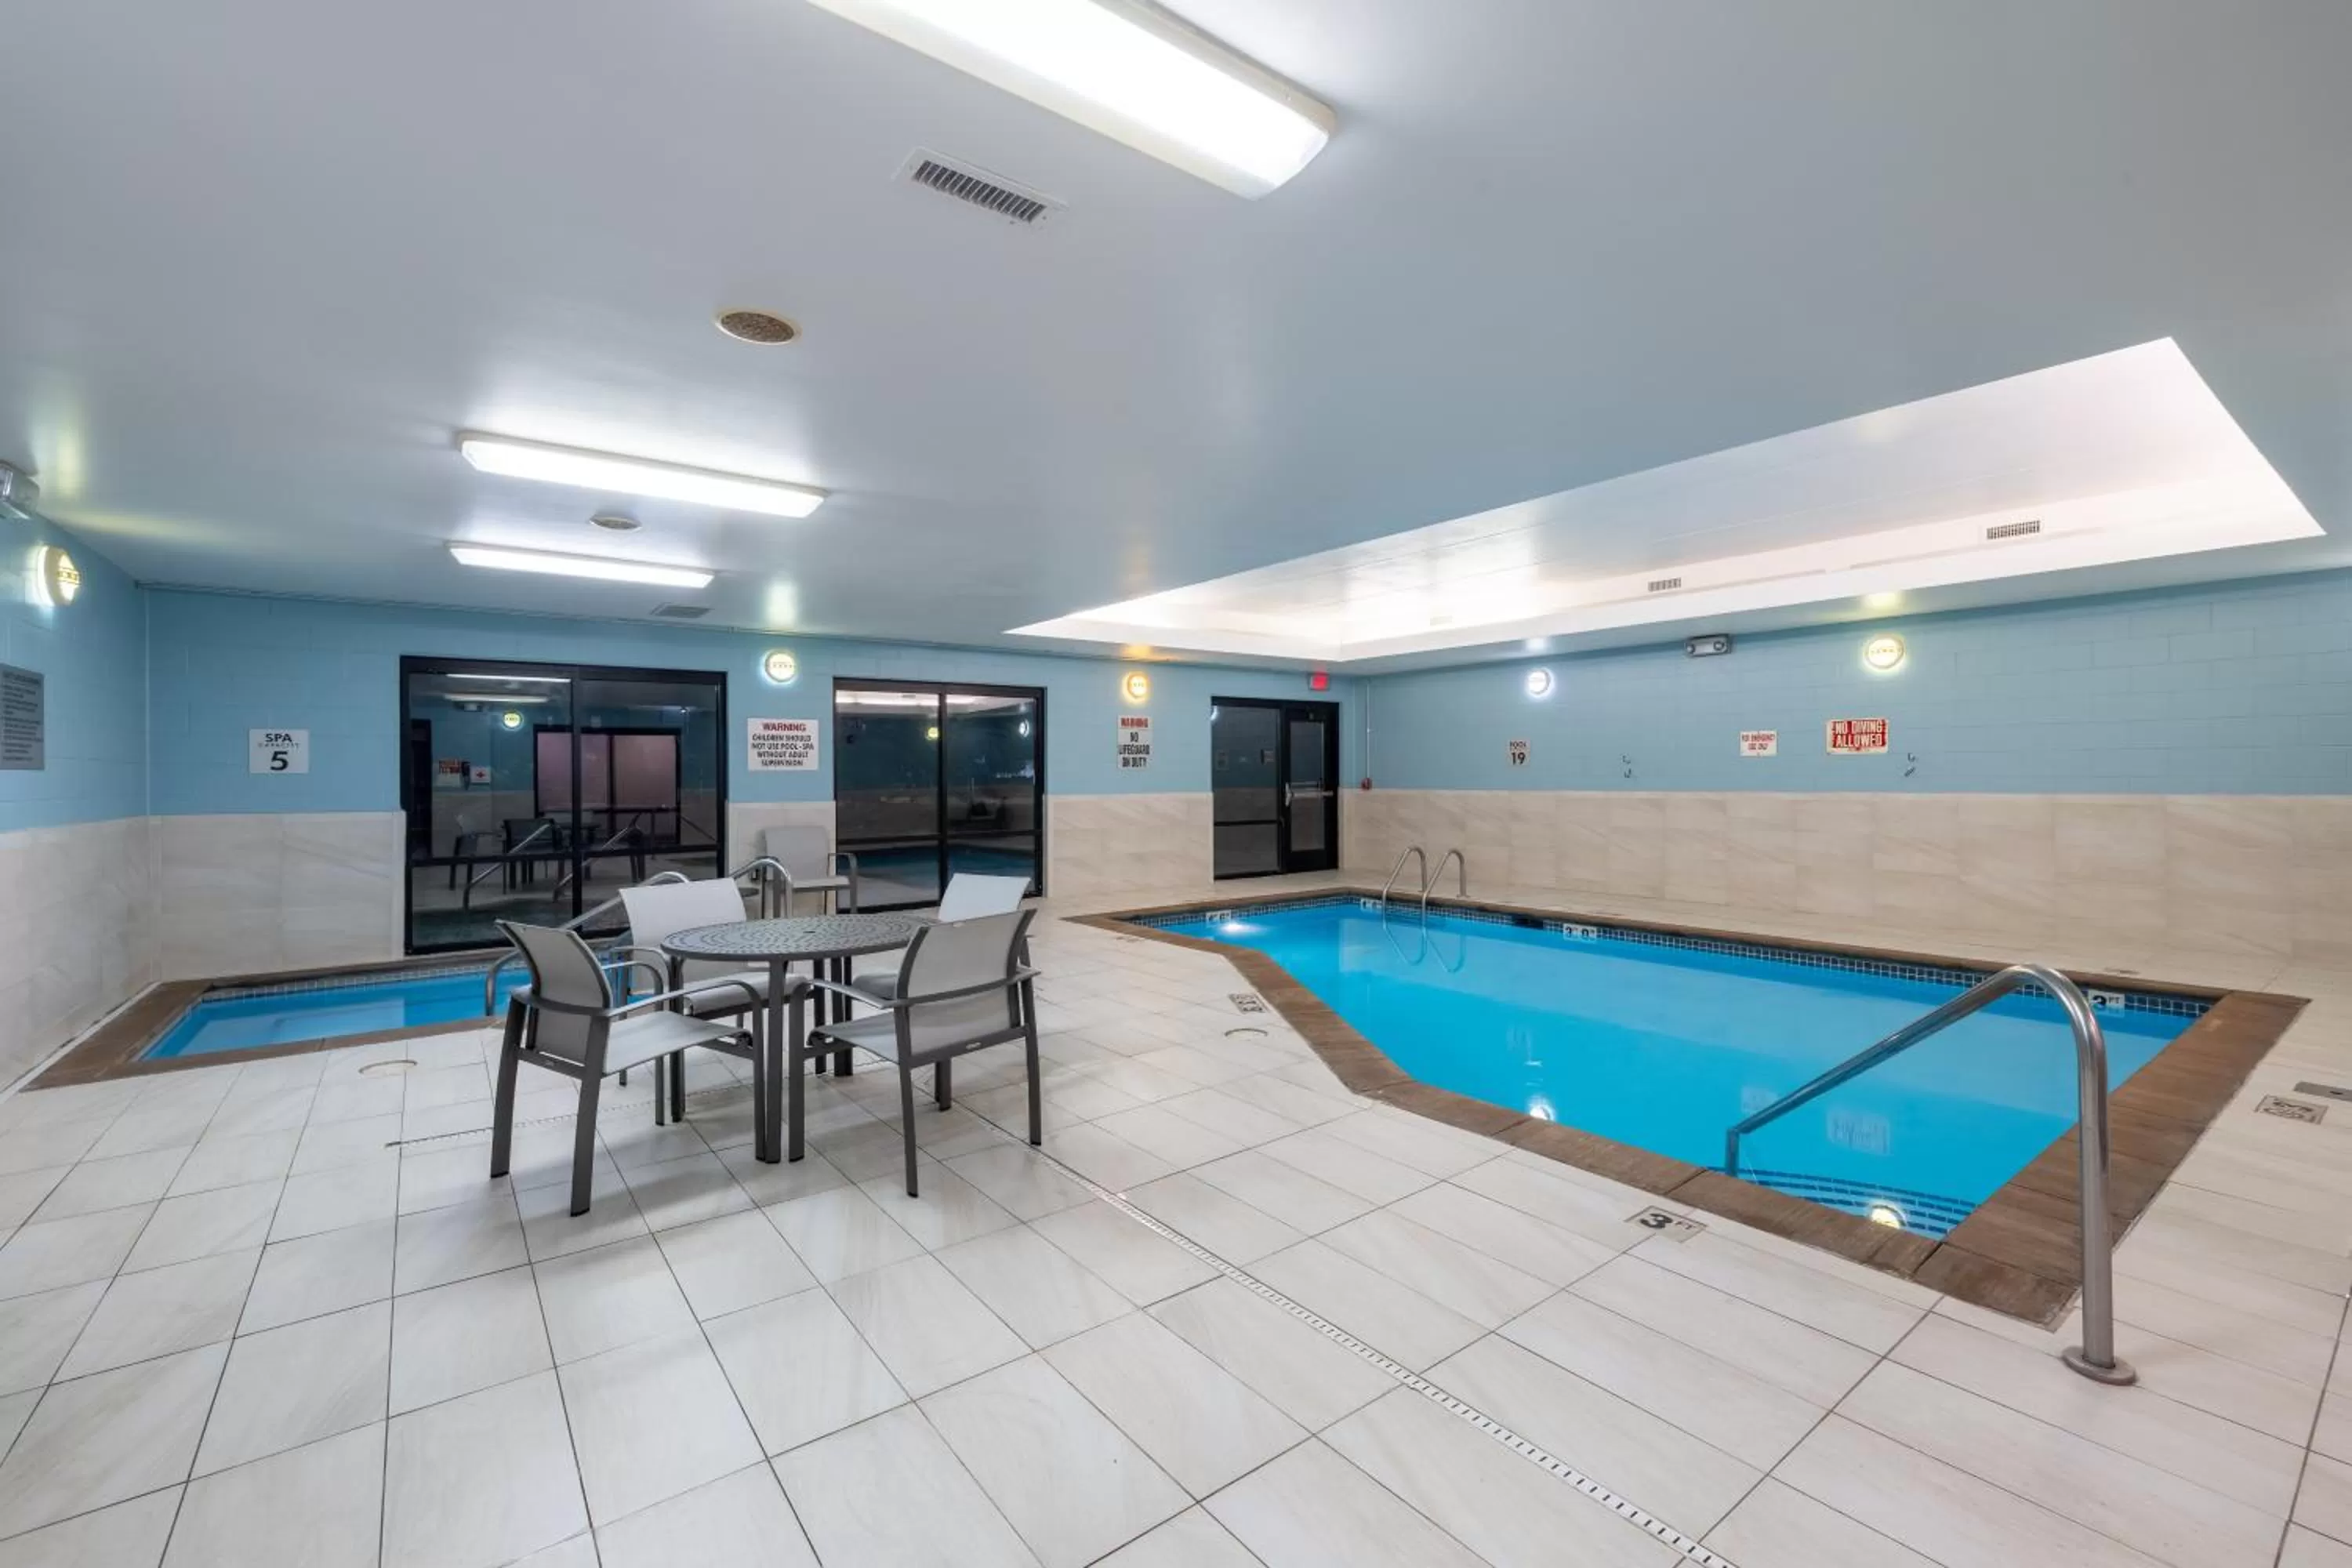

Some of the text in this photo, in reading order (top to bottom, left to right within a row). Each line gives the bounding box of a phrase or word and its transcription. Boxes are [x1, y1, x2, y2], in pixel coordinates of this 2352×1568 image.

[762, 723, 806, 731] WARNING
[1835, 720, 1882, 734] NO DIVING
[265, 733, 292, 742] SPA
[1130, 731, 1139, 742] NO
[1835, 733, 1882, 746] ALLOWED
[1119, 744, 1150, 755] LIFEGUARD
[270, 750, 289, 771] 5
[1512, 752, 1526, 765] 19
[2092, 995, 2107, 1009] 3
[1639, 1213, 1674, 1229] 3
